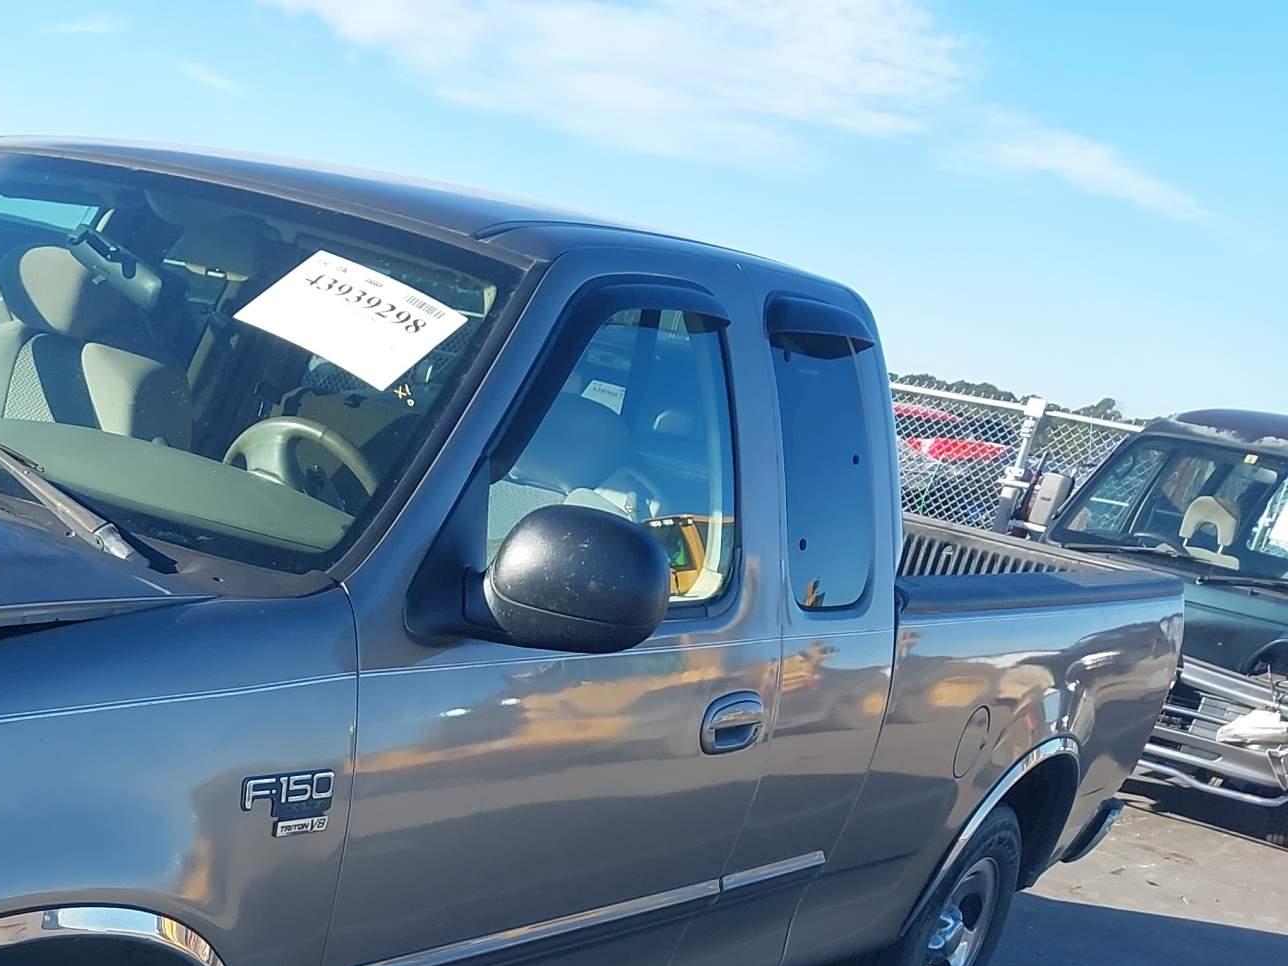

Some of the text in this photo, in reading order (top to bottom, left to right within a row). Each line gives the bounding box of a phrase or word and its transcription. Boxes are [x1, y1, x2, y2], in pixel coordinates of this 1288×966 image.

[305, 274, 427, 334] 43939298
[279, 817, 327, 833] TRITON V8
